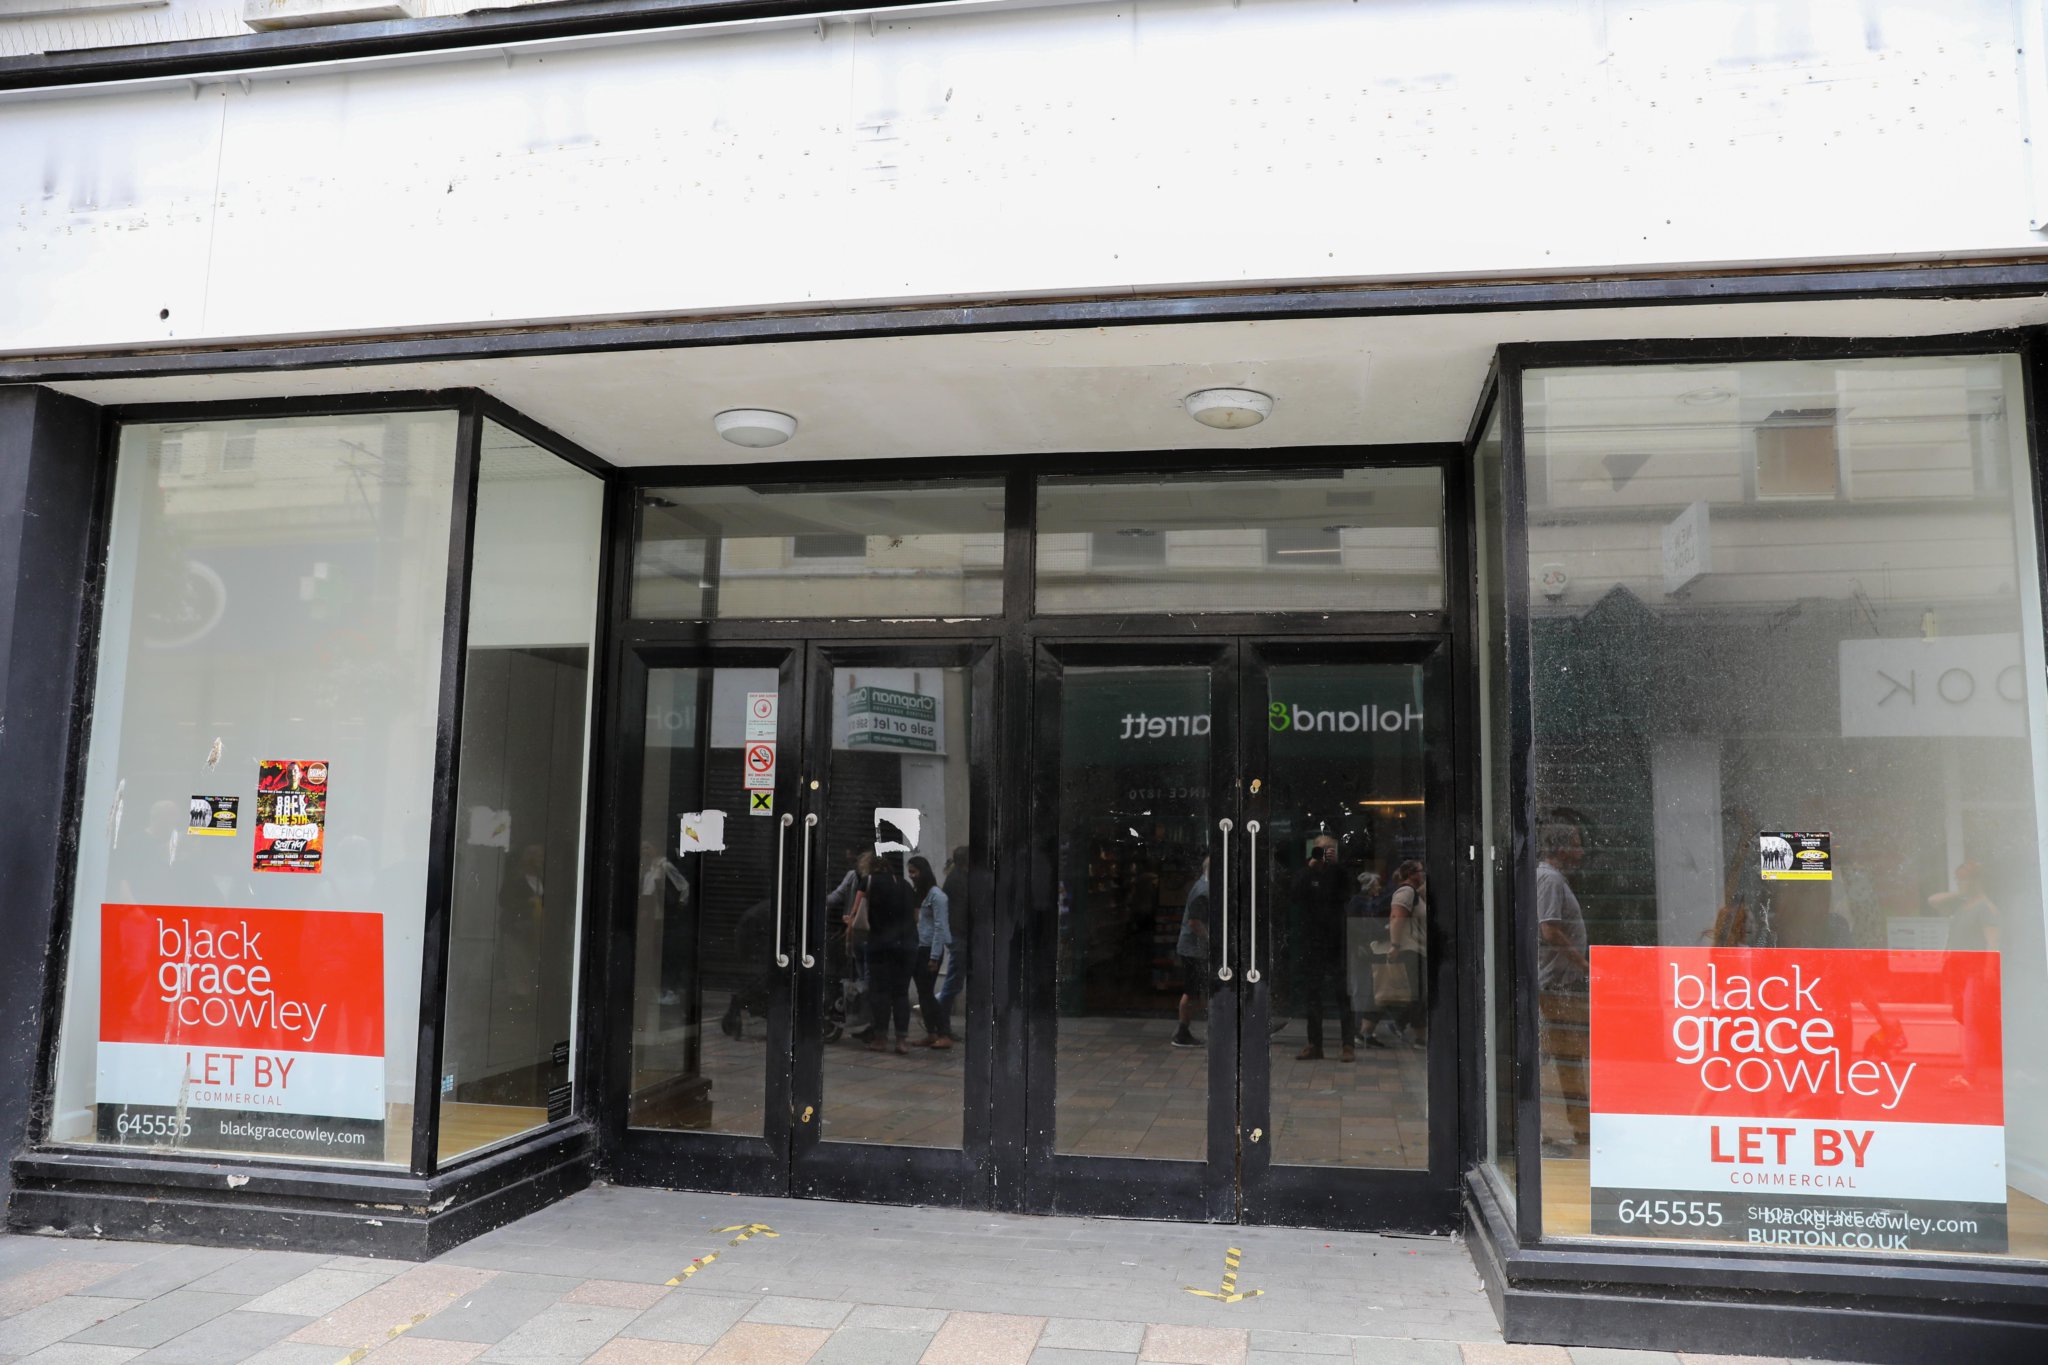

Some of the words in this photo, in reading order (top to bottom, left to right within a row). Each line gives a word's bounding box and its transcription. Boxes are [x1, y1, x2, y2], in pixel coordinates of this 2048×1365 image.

[274, 815, 290, 825] THE
[157, 918, 263, 961] black
[159, 960, 272, 1002] grace
[1670, 962, 1823, 1012] black
[178, 990, 327, 1042] cowley
[1672, 1012, 1835, 1064] grace
[185, 1051, 244, 1085] LET
[254, 1057, 296, 1088] BY
[1700, 1047, 1916, 1109] cowley
[194, 1089, 283, 1107] COMMERCIAL
[116, 1112, 192, 1138] 645555
[219, 1121, 366, 1146] blackgracecowley.com
[1710, 1125, 1797, 1166] LET
[1814, 1128, 1875, 1168] BY
[1730, 1171, 1857, 1190] COMMERCIAL
[1617, 1199, 1723, 1228] 645555
[1764, 1207, 1978, 1234] blackgracecowley.com
[1747, 1228, 1909, 1250] BURTON.CO.UK
